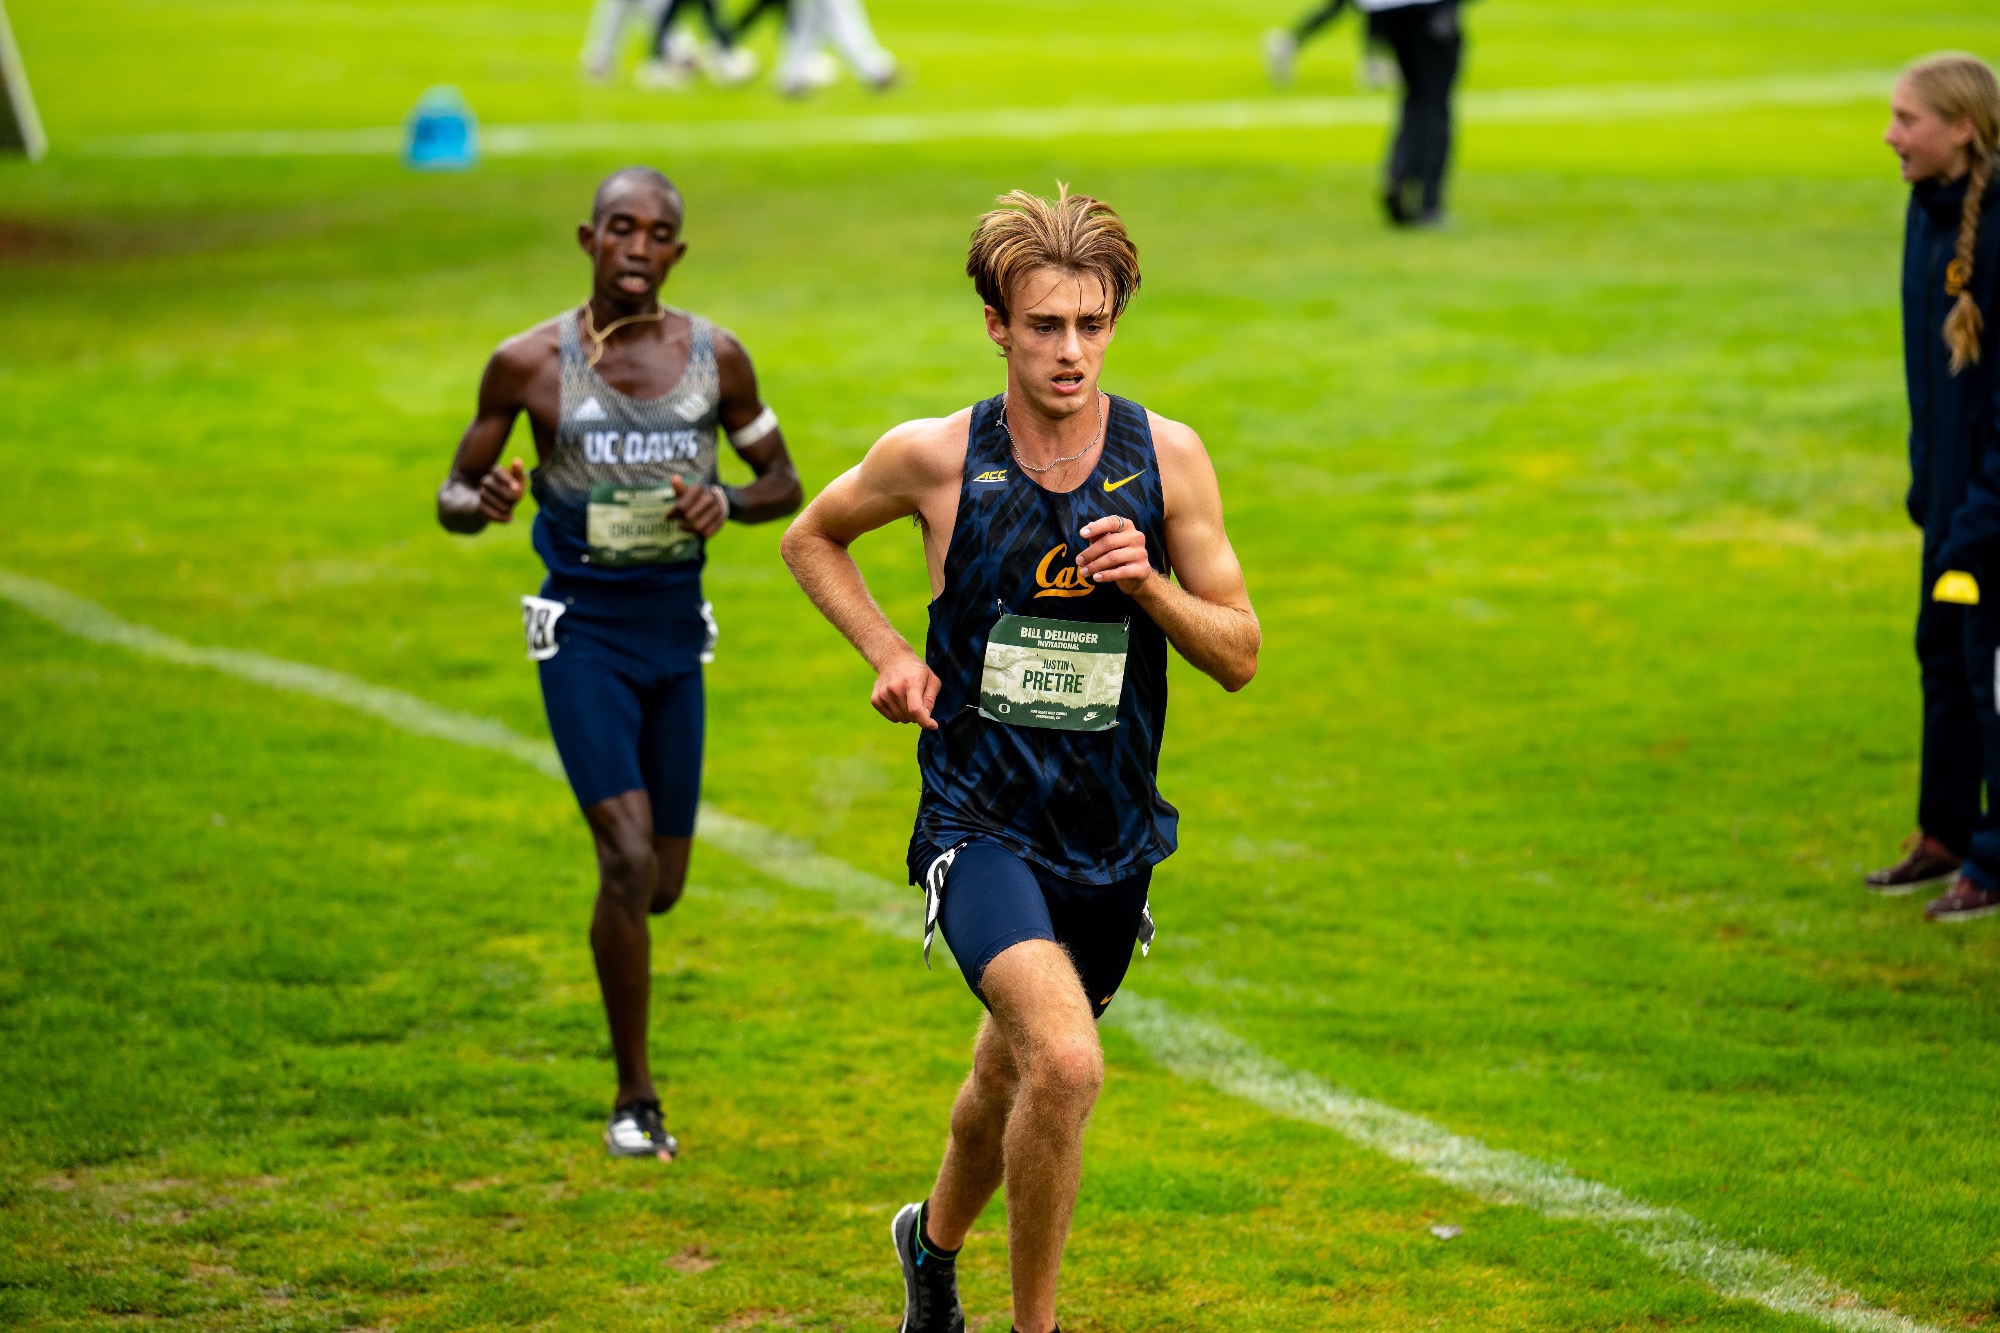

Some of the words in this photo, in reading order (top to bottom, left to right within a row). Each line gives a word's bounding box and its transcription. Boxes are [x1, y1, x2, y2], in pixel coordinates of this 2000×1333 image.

[583, 430, 619, 464] UC
[623, 429, 699, 464] DAVIS
[975, 469, 1008, 481] ACC
[1020, 626, 1042, 639] BILL
[1044, 630, 1099, 644] DELLINGER
[1037, 640, 1080, 651] INVITATIONAL
[1041, 658, 1070, 671] JUSTIN
[1022, 669, 1085, 694] PRETRE
